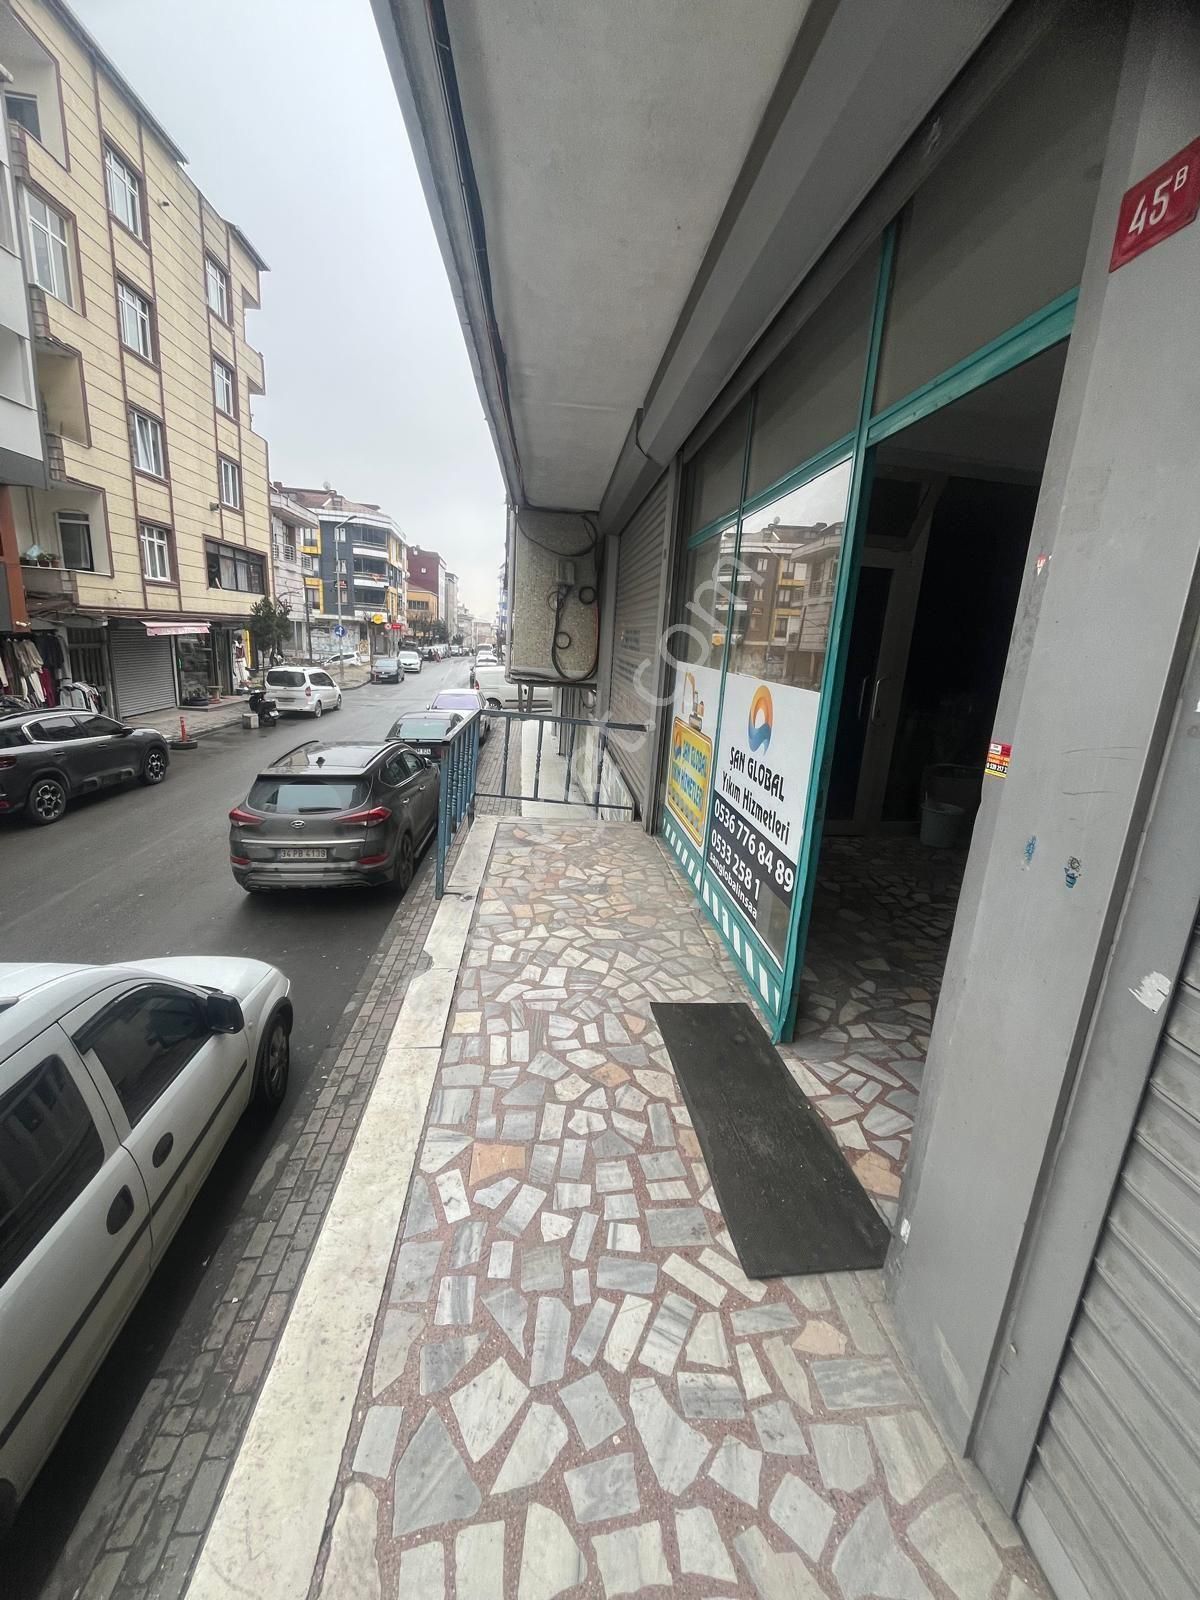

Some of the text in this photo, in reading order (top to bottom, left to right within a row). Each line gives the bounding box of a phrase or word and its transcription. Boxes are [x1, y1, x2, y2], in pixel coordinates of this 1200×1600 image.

[721, 770, 741, 804] Yıkım
[742, 787, 790, 846] Hizmetleri
[730, 746, 785, 803] ŞAN GLOBAL
[711, 828, 732, 866] 0533
[732, 853, 753, 890] 258
[714, 798, 794, 893] 0536 776 84 89
